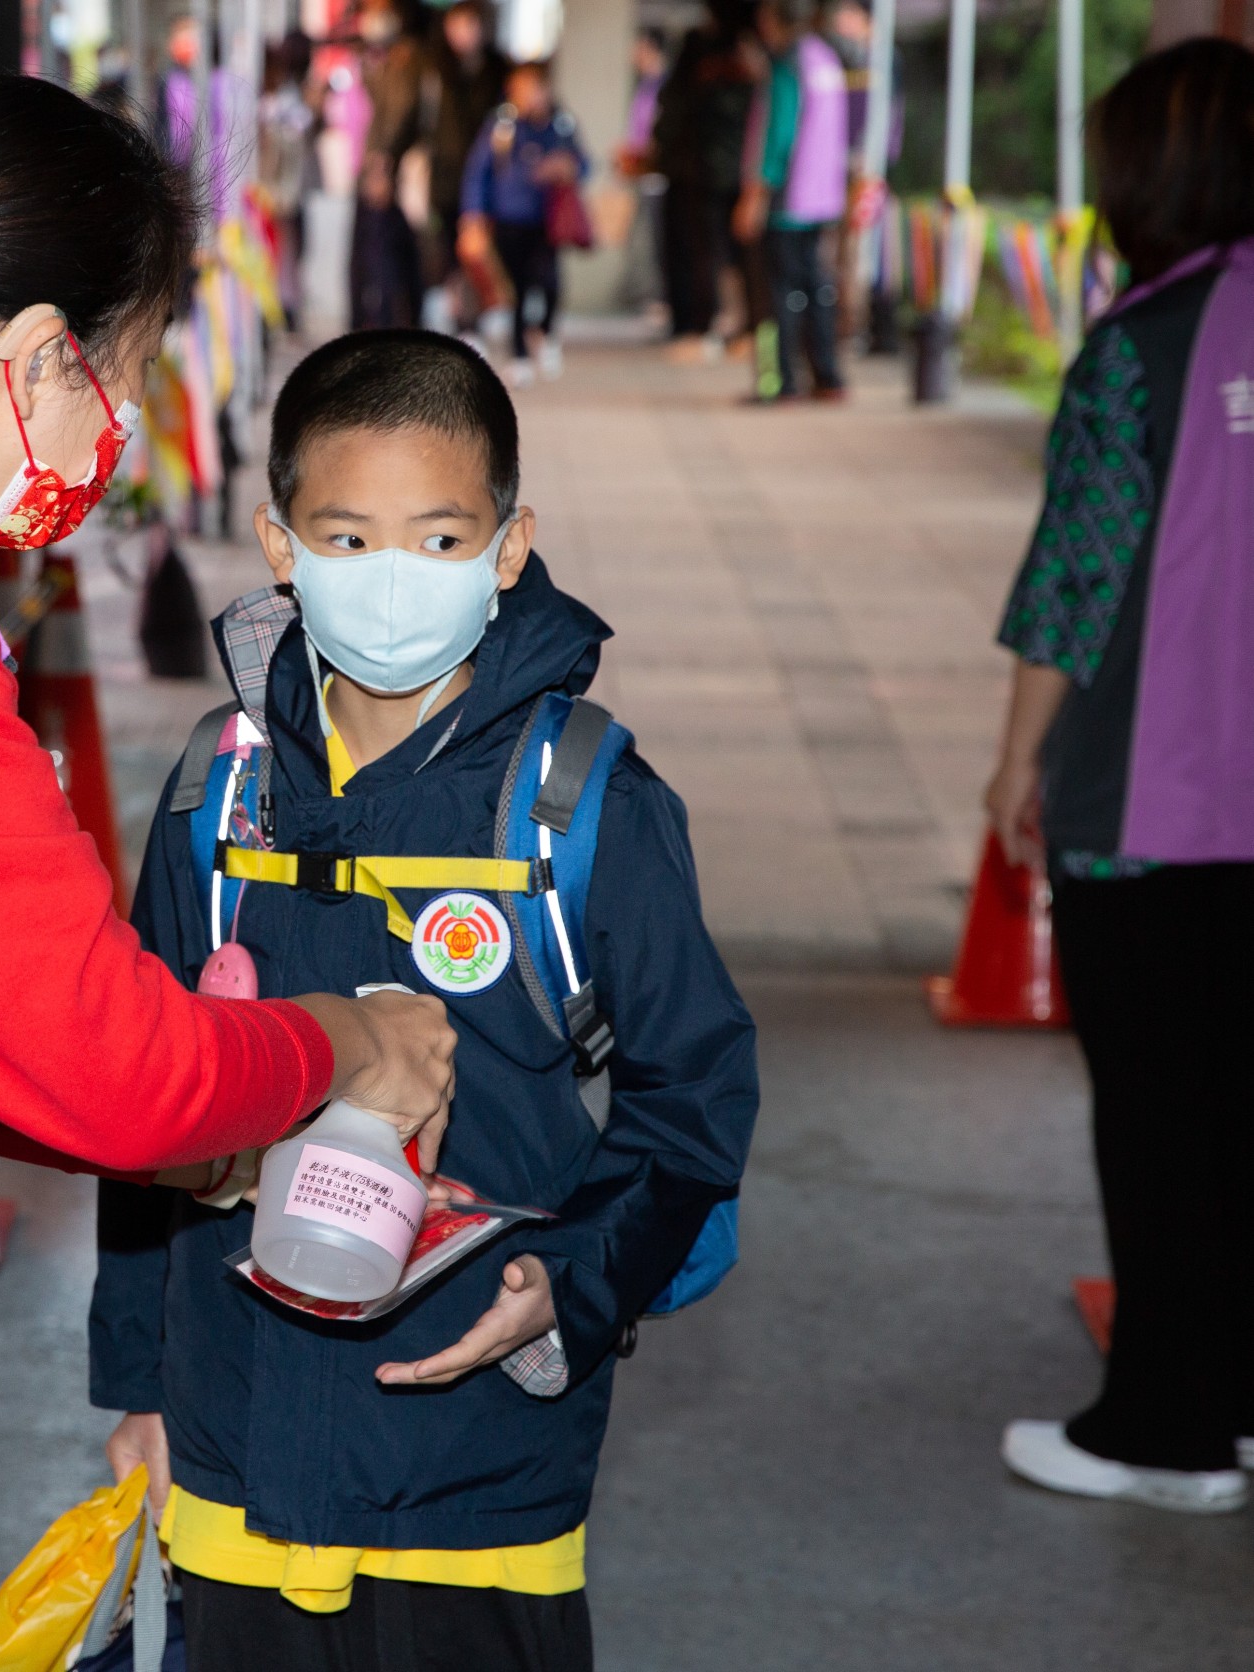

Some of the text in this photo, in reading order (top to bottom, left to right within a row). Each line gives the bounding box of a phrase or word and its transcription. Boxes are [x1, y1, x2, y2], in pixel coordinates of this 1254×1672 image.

[308, 1161, 394, 1198] 乾洗手液(75%酒精)
[293, 1194, 368, 1222] 期末需繳回健康中心
